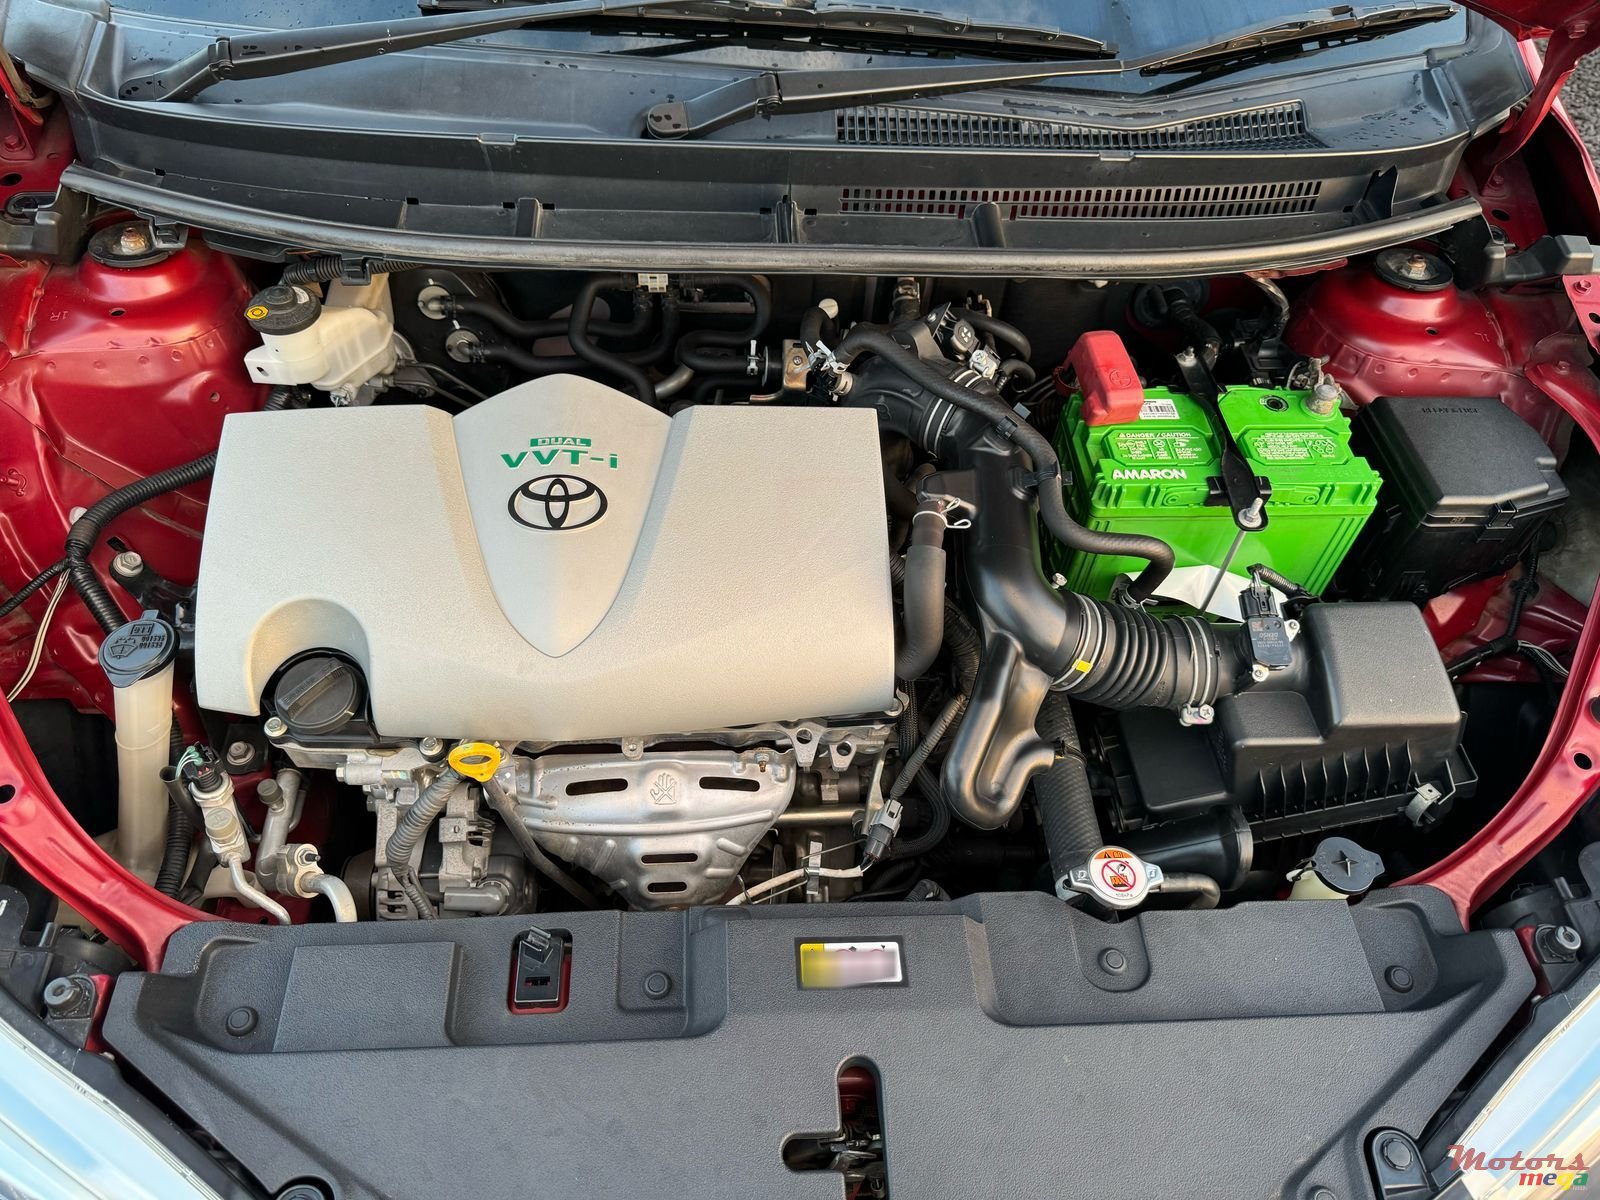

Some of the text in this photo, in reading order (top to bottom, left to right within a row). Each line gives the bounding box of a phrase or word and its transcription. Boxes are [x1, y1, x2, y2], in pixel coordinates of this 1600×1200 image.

[538, 437, 586, 446] DUAL
[500, 448, 618, 469] VVT-i
[1112, 468, 1187, 480] AMARON
